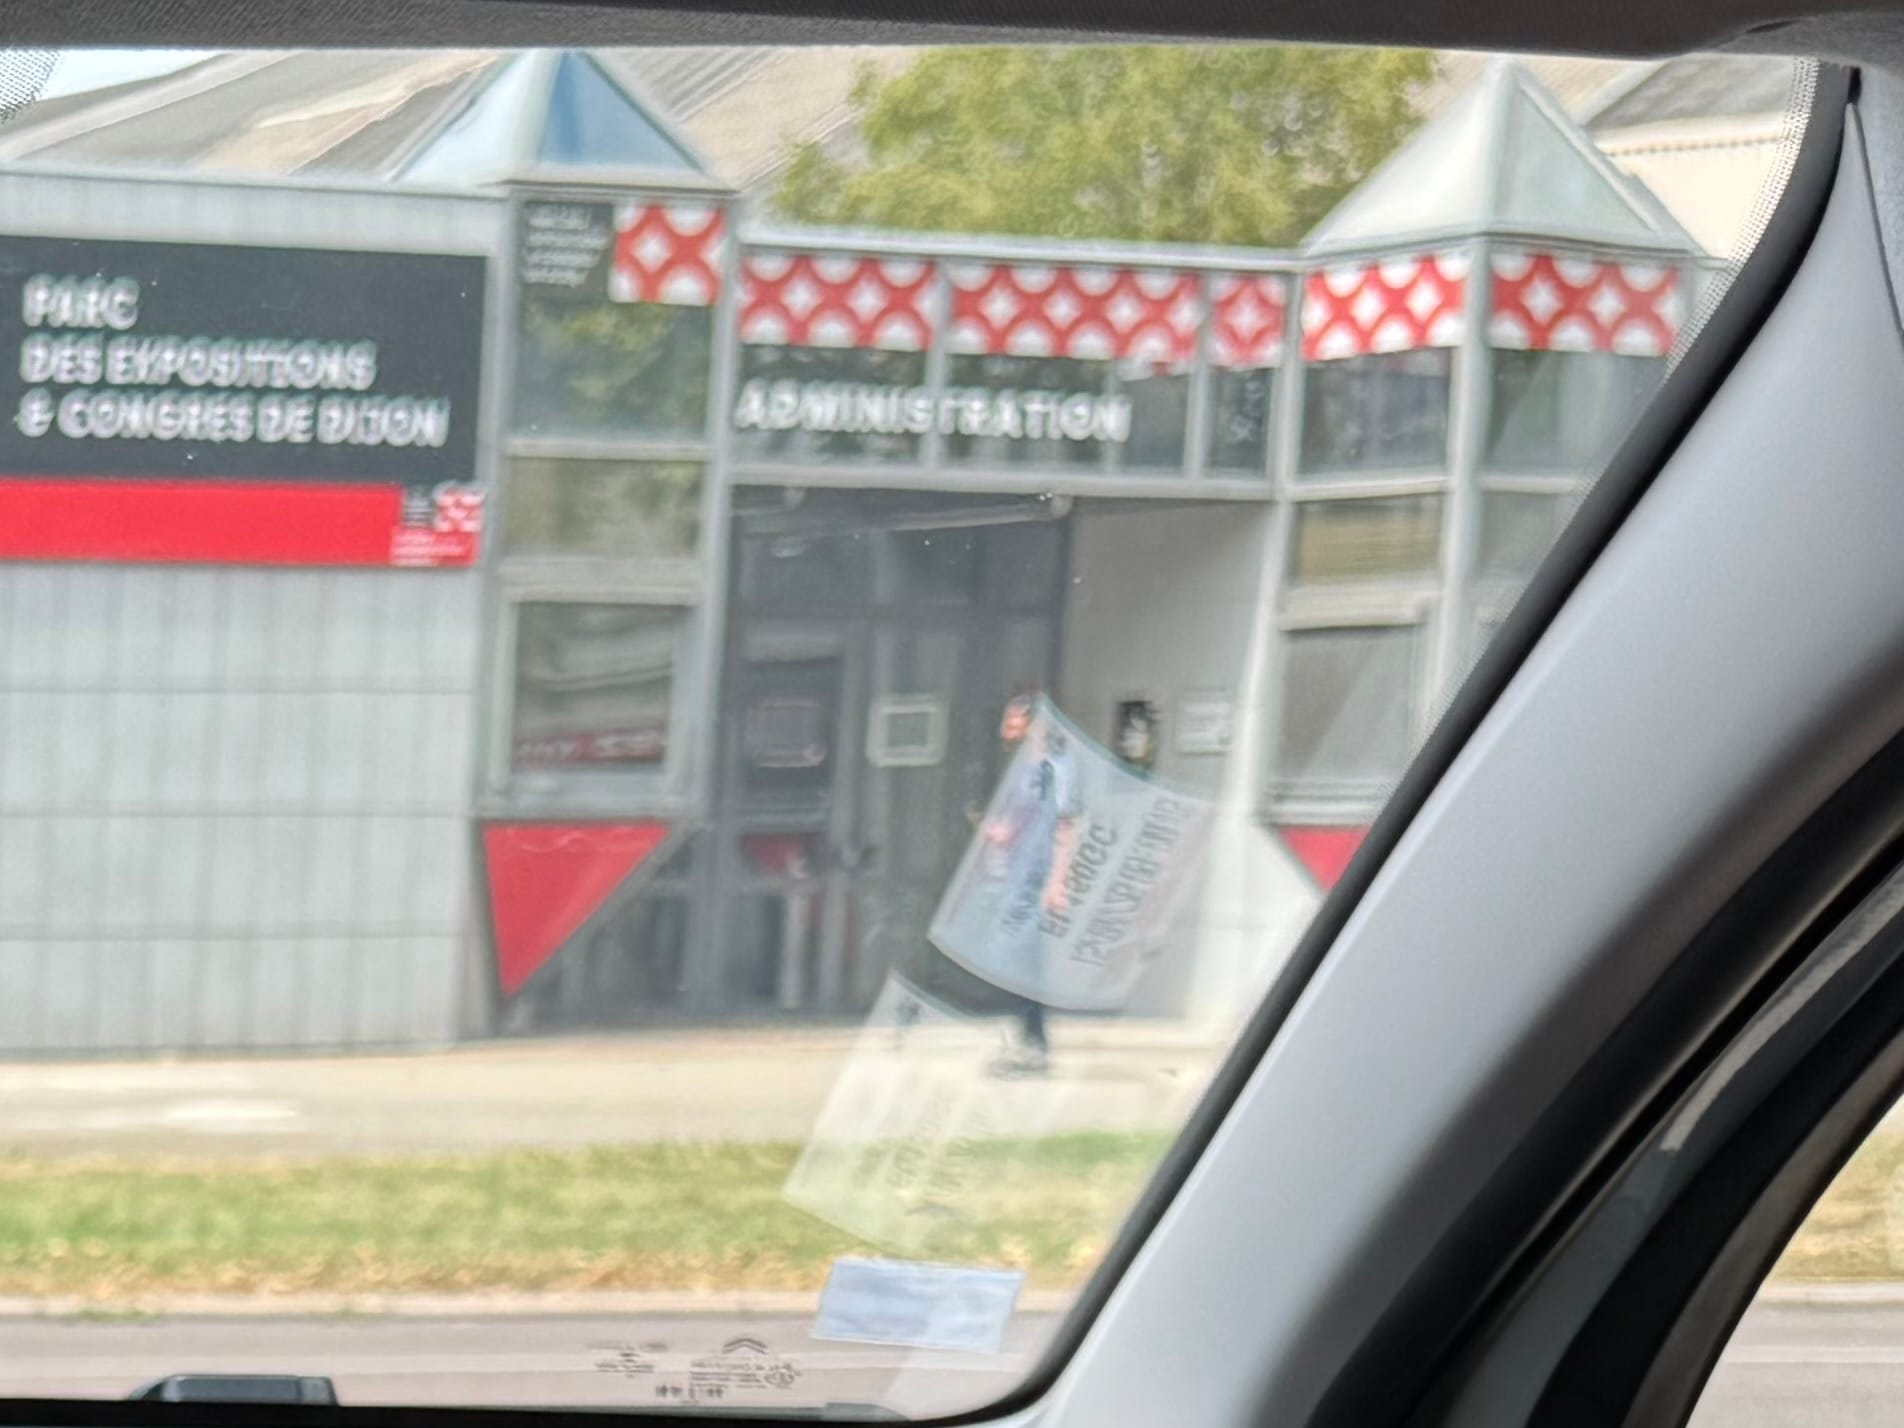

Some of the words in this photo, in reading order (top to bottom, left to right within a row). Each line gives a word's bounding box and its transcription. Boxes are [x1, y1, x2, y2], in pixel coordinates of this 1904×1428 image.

[22, 274, 139, 330] PARC
[19, 332, 103, 384] DES
[105, 334, 378, 391] EXPOSITIONS
[256, 392, 314, 444] DE
[315, 394, 452, 448] DIJON
[735, 378, 1132, 442] ADMINISTRATION
